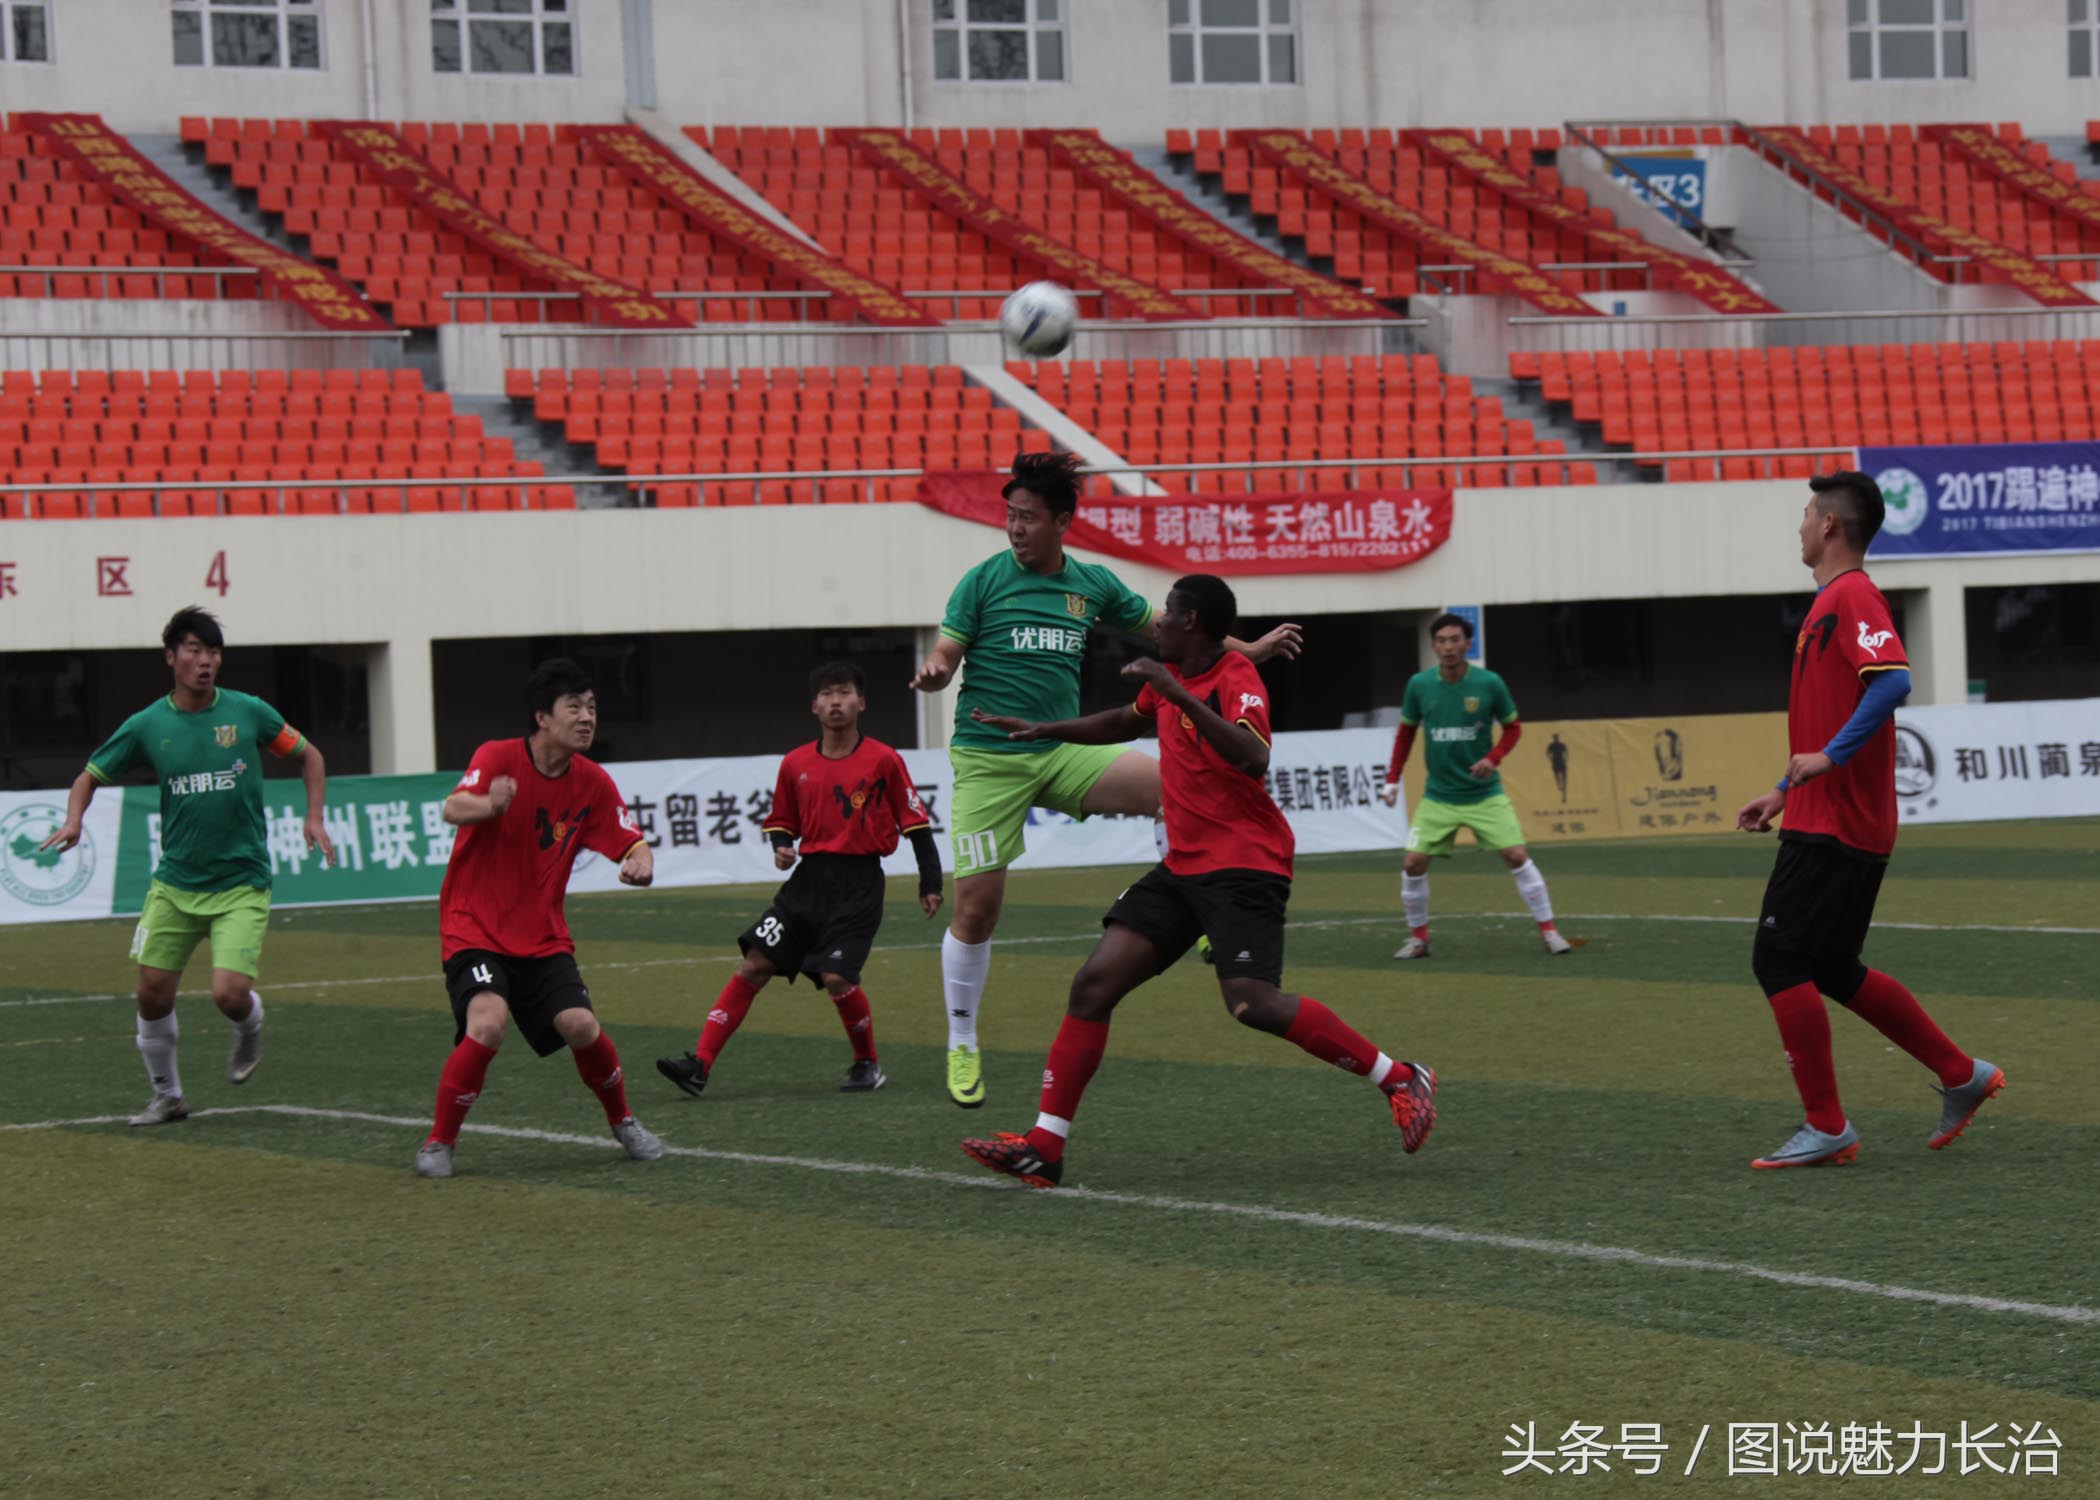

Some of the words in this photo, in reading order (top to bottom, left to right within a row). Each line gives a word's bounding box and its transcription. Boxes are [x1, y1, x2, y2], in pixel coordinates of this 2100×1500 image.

[1154, 504, 1255, 546] 弱碱性
[1266, 499, 1432, 543] 天然山泉水
[98, 556, 133, 597] 区
[205, 550, 230, 597] 4
[957, 829, 999, 871] 90
[755, 916, 785, 947] 35
[472, 963, 493, 984] 4
